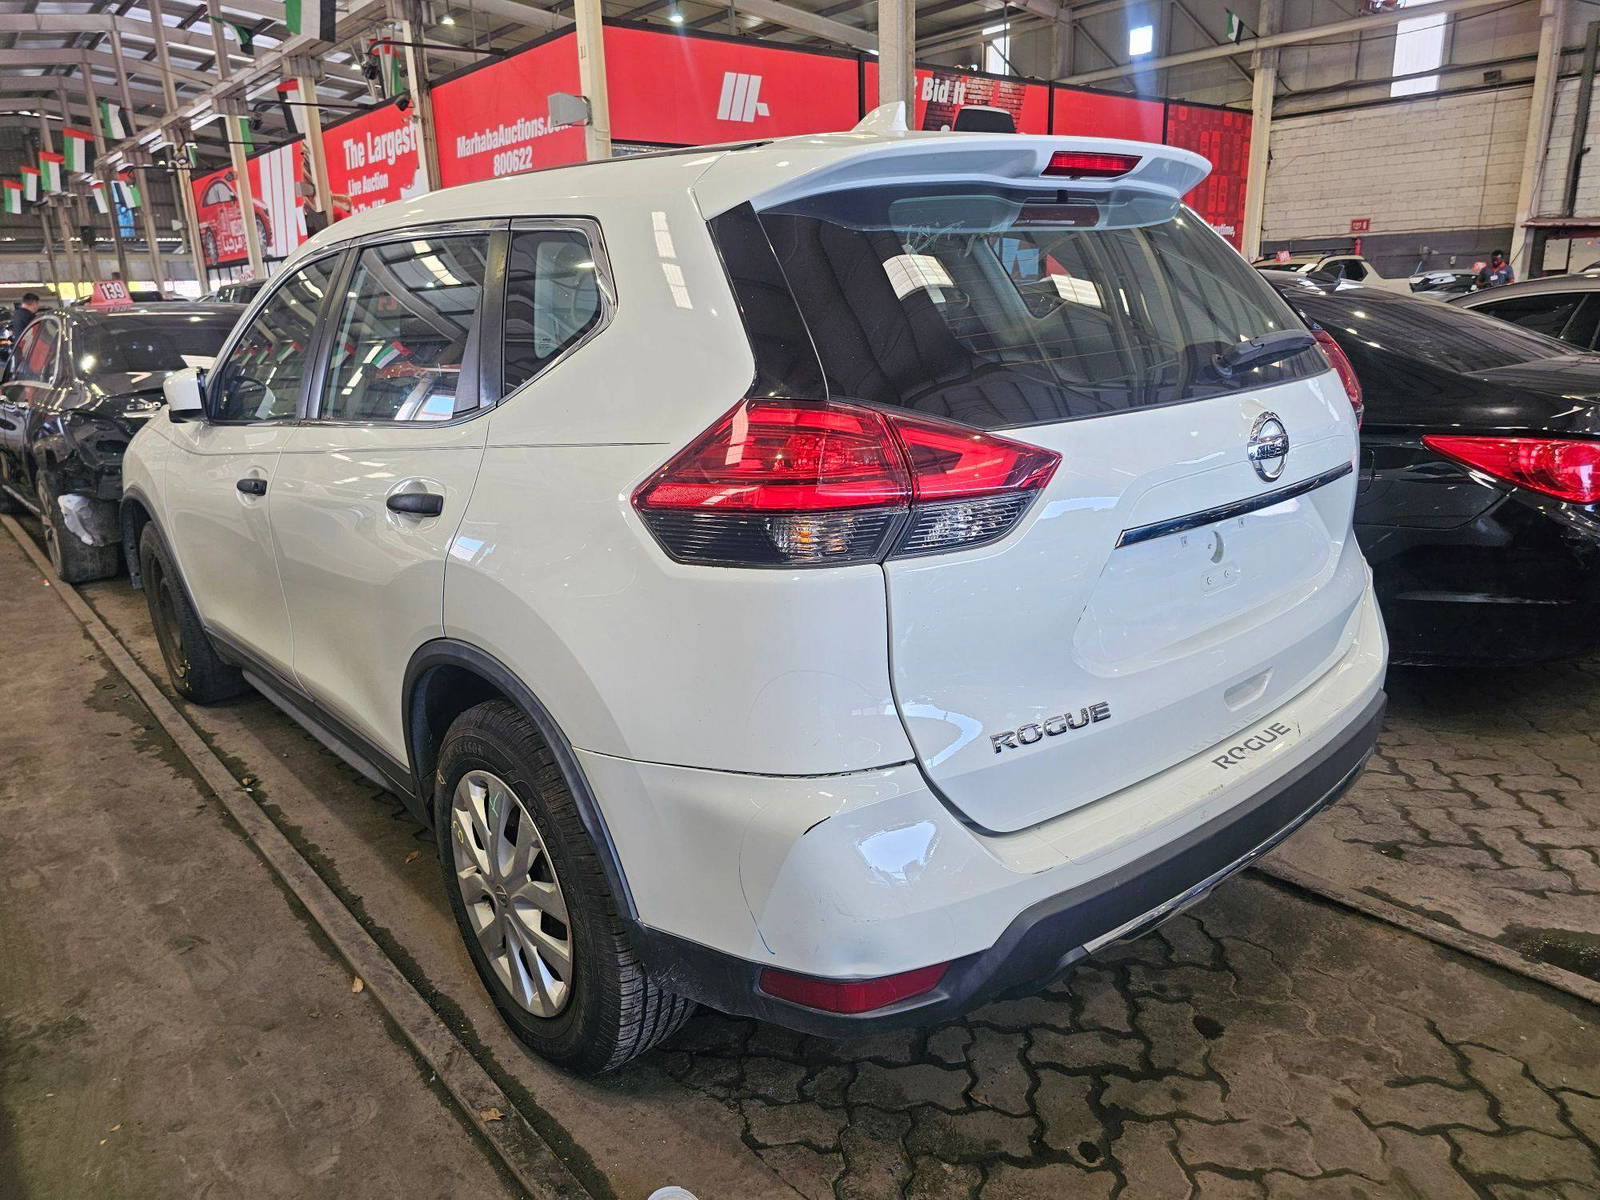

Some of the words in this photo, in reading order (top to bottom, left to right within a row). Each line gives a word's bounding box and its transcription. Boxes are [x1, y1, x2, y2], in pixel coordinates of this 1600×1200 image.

[921, 77, 950, 103] Bid
[343, 138, 366, 171] The
[366, 121, 417, 166] Largest
[456, 115, 573, 159] MarhabaAuctions.c
[493, 145, 533, 177] 800622
[348, 178, 362, 197] Live
[362, 172, 389, 194] Auction
[101, 282, 126, 300] 139
[989, 700, 1112, 755] ROGUE
[1211, 721, 1292, 770] ROGUE
